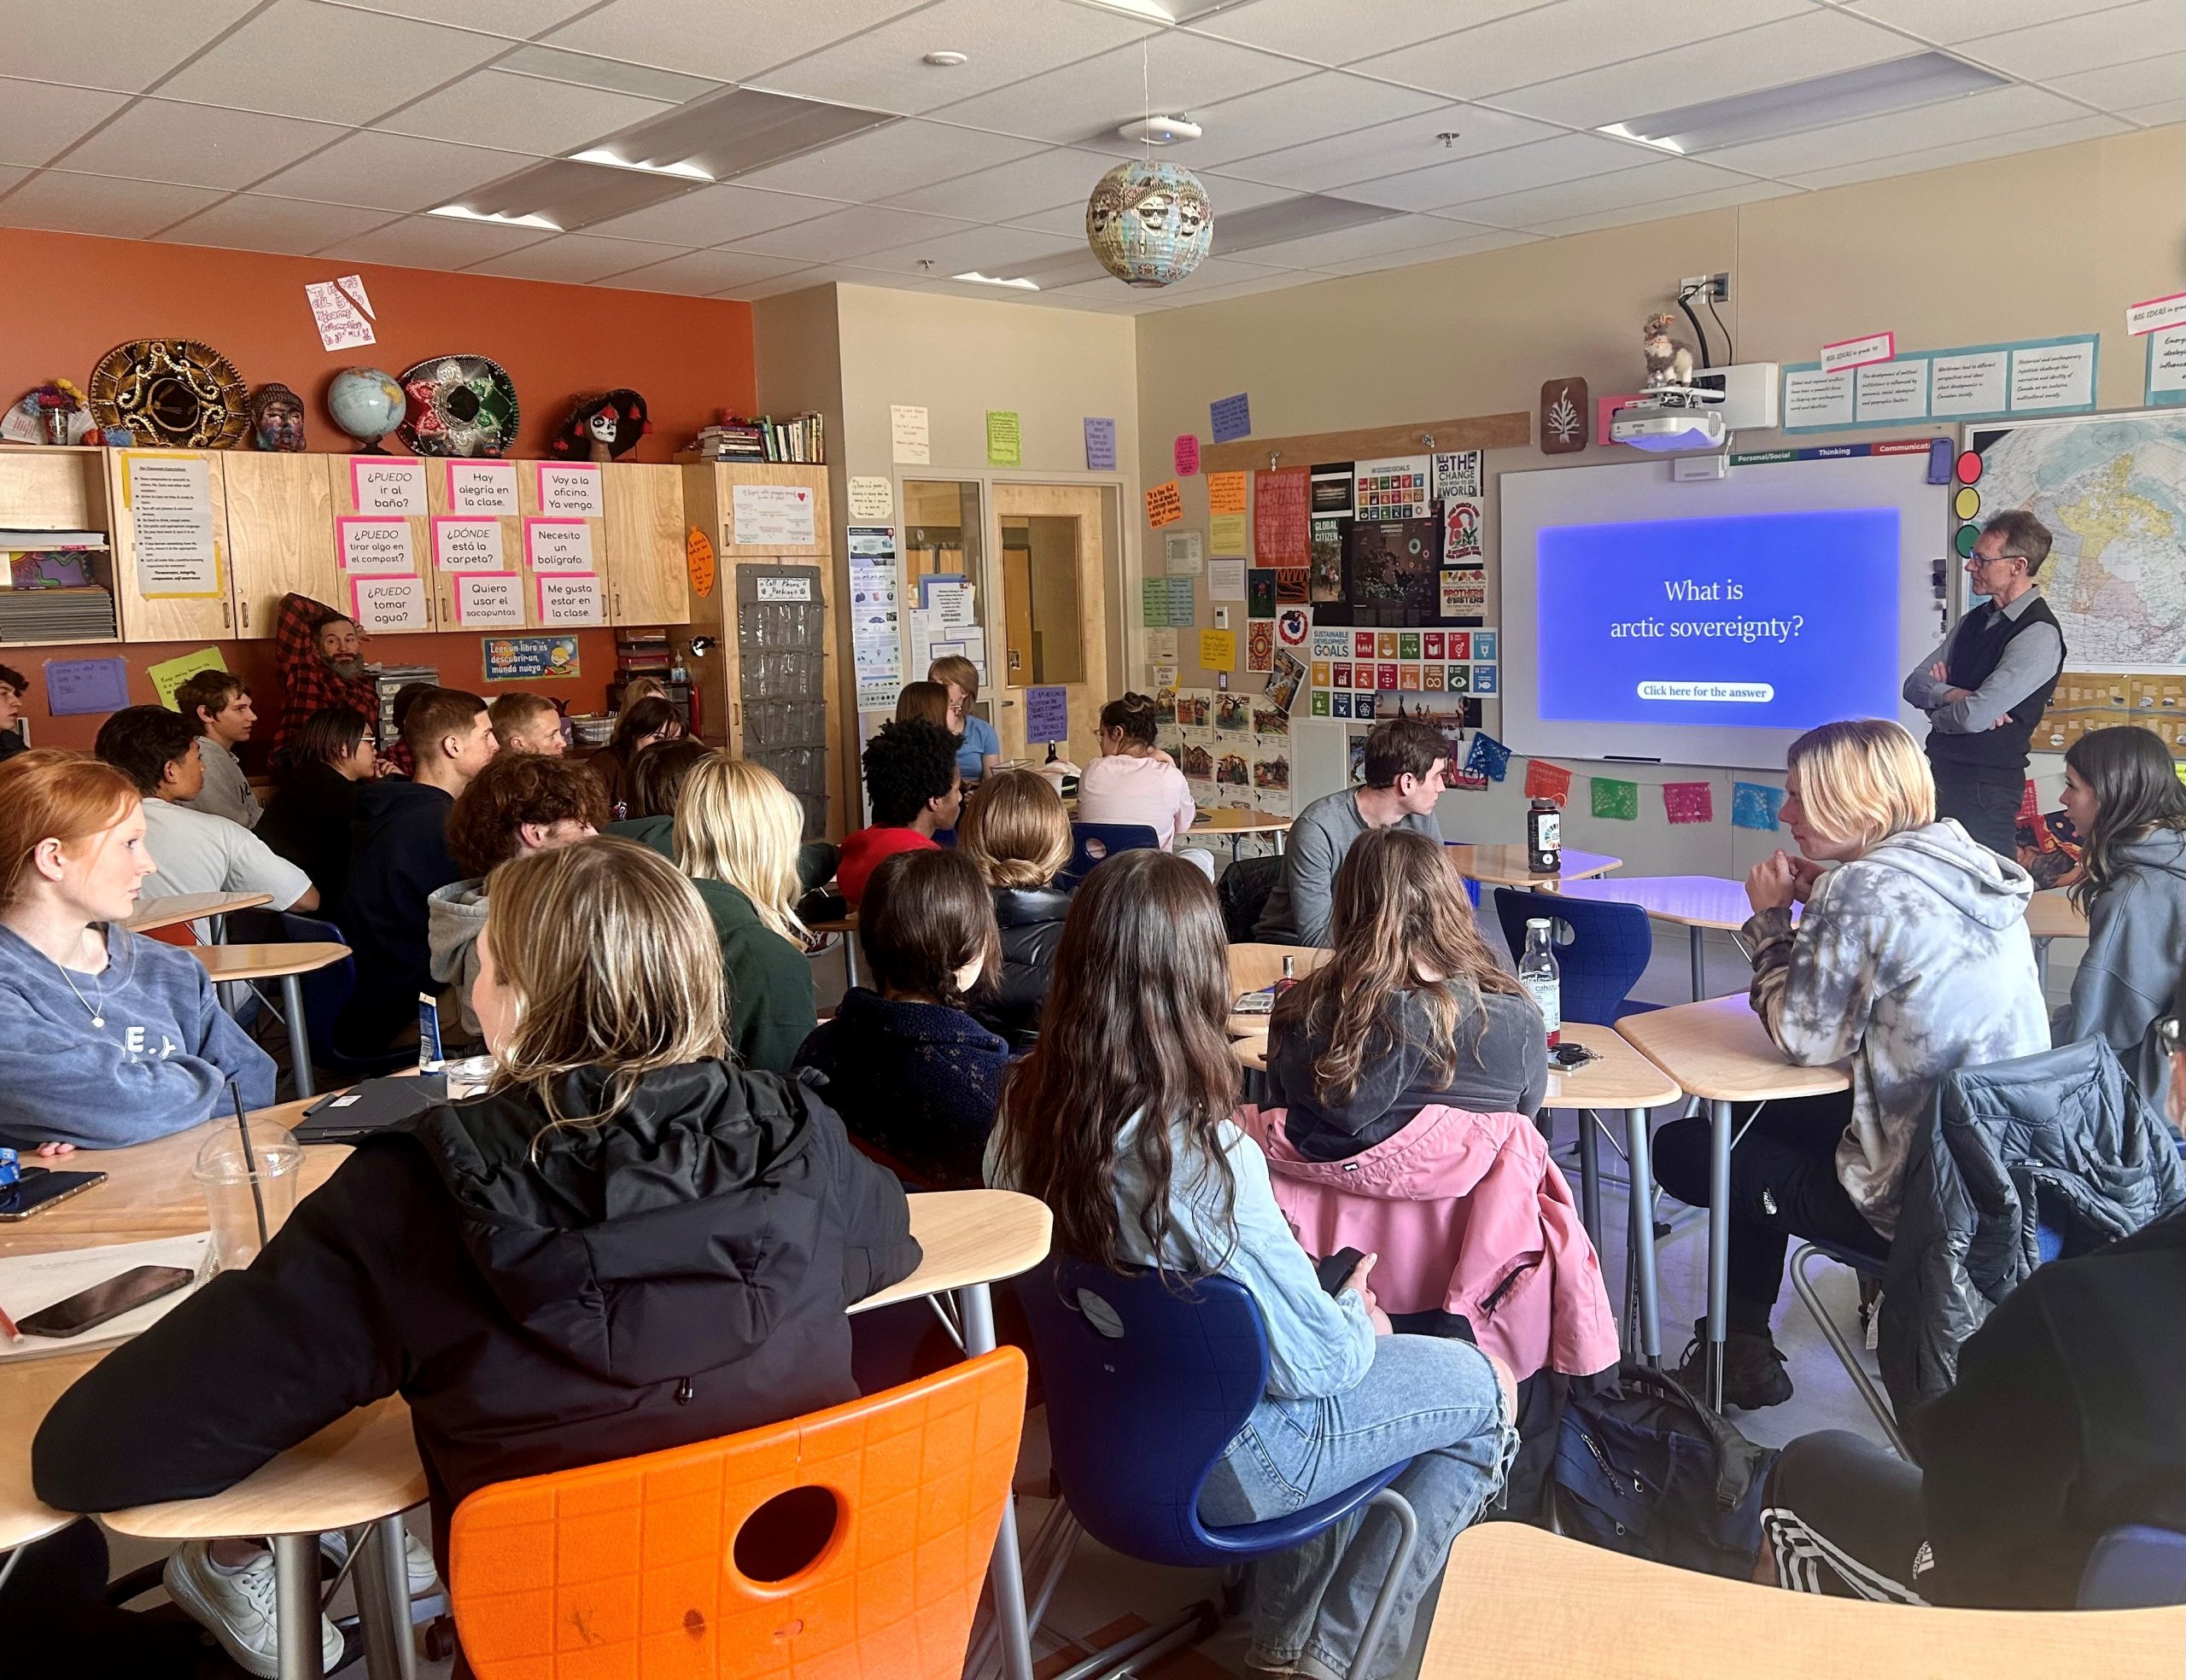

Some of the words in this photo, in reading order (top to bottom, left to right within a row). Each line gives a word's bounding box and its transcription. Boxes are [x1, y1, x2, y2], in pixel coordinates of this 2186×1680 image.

[2146, 308, 2166, 318] IDEAS
[1738, 452, 1791, 463] Personal/Social
[1818, 446, 1850, 457] Thinking
[1879, 442, 1932, 452] Communicati
[1439, 456, 1449, 472] BE
[1449, 453, 1475, 471] THE
[367, 472, 412, 482] ¿PUEDO
[474, 473, 494, 483] Hay
[1439, 470, 1475, 481] CHANGE
[552, 475, 569, 487] Voy
[580, 476, 589, 485] la
[1265, 474, 1286, 489] YOU
[1286, 473, 1305, 488] ARE
[390, 486, 401, 494] al
[459, 485, 494, 495] alegría
[554, 487, 588, 498] oficina.
[1442, 485, 1475, 497] WORLD
[1258, 487, 1306, 506] NEUTRAL
[374, 498, 409, 508] baño?
[465, 498, 474, 506] la
[476, 498, 505, 506] clase.
[549, 500, 561, 509] Ya
[563, 502, 594, 511] vengo.
[1315, 521, 1338, 531] GLOBAL
[354, 529, 399, 540] ¿PUEDO
[447, 528, 491, 540] ¿DÓNDE
[538, 530, 581, 540] Necesito
[1315, 532, 1338, 541] CITIZEN
[349, 542, 370, 551] tirar
[371, 542, 391, 551] algo
[452, 542, 474, 551] está
[476, 542, 487, 551] la
[362, 552, 404, 564] compost?
[447, 554, 494, 565] carpeta?
[537, 555, 584, 566] bolígrafo.
[471, 583, 507, 593] Quiero
[781, 579, 800, 587] Phone
[367, 586, 412, 598] ¿PUEDO
[547, 584, 564, 593] Me
[565, 585, 593, 594] gusta
[772, 587, 793, 597] Parking
[1663, 579, 1721, 602] What
[1726, 578, 1744, 601] is
[374, 600, 407, 610] tomar
[500, 596, 508, 605] el
[551, 597, 576, 605] estar
[578, 597, 591, 605] en
[375, 612, 408, 624] agua?
[466, 609, 516, 618] sacapuntas
[552, 609, 561, 617] la
[563, 609, 591, 617] clase.
[1610, 616, 1664, 639] arctic
[1669, 615, 1803, 644] sovereignty?
[490, 644, 506, 653] Leer
[520, 644, 537, 652] libro
[1314, 645, 1349, 657] GOALS
[491, 655, 528, 663] descubrir
[492, 665, 517, 674] mundo
[1643, 685, 1668, 697] Click
[1669, 685, 1692, 697] here
[1693, 685, 1708, 697] for
[1710, 686, 1727, 697] the
[1729, 689, 1767, 699] answer
